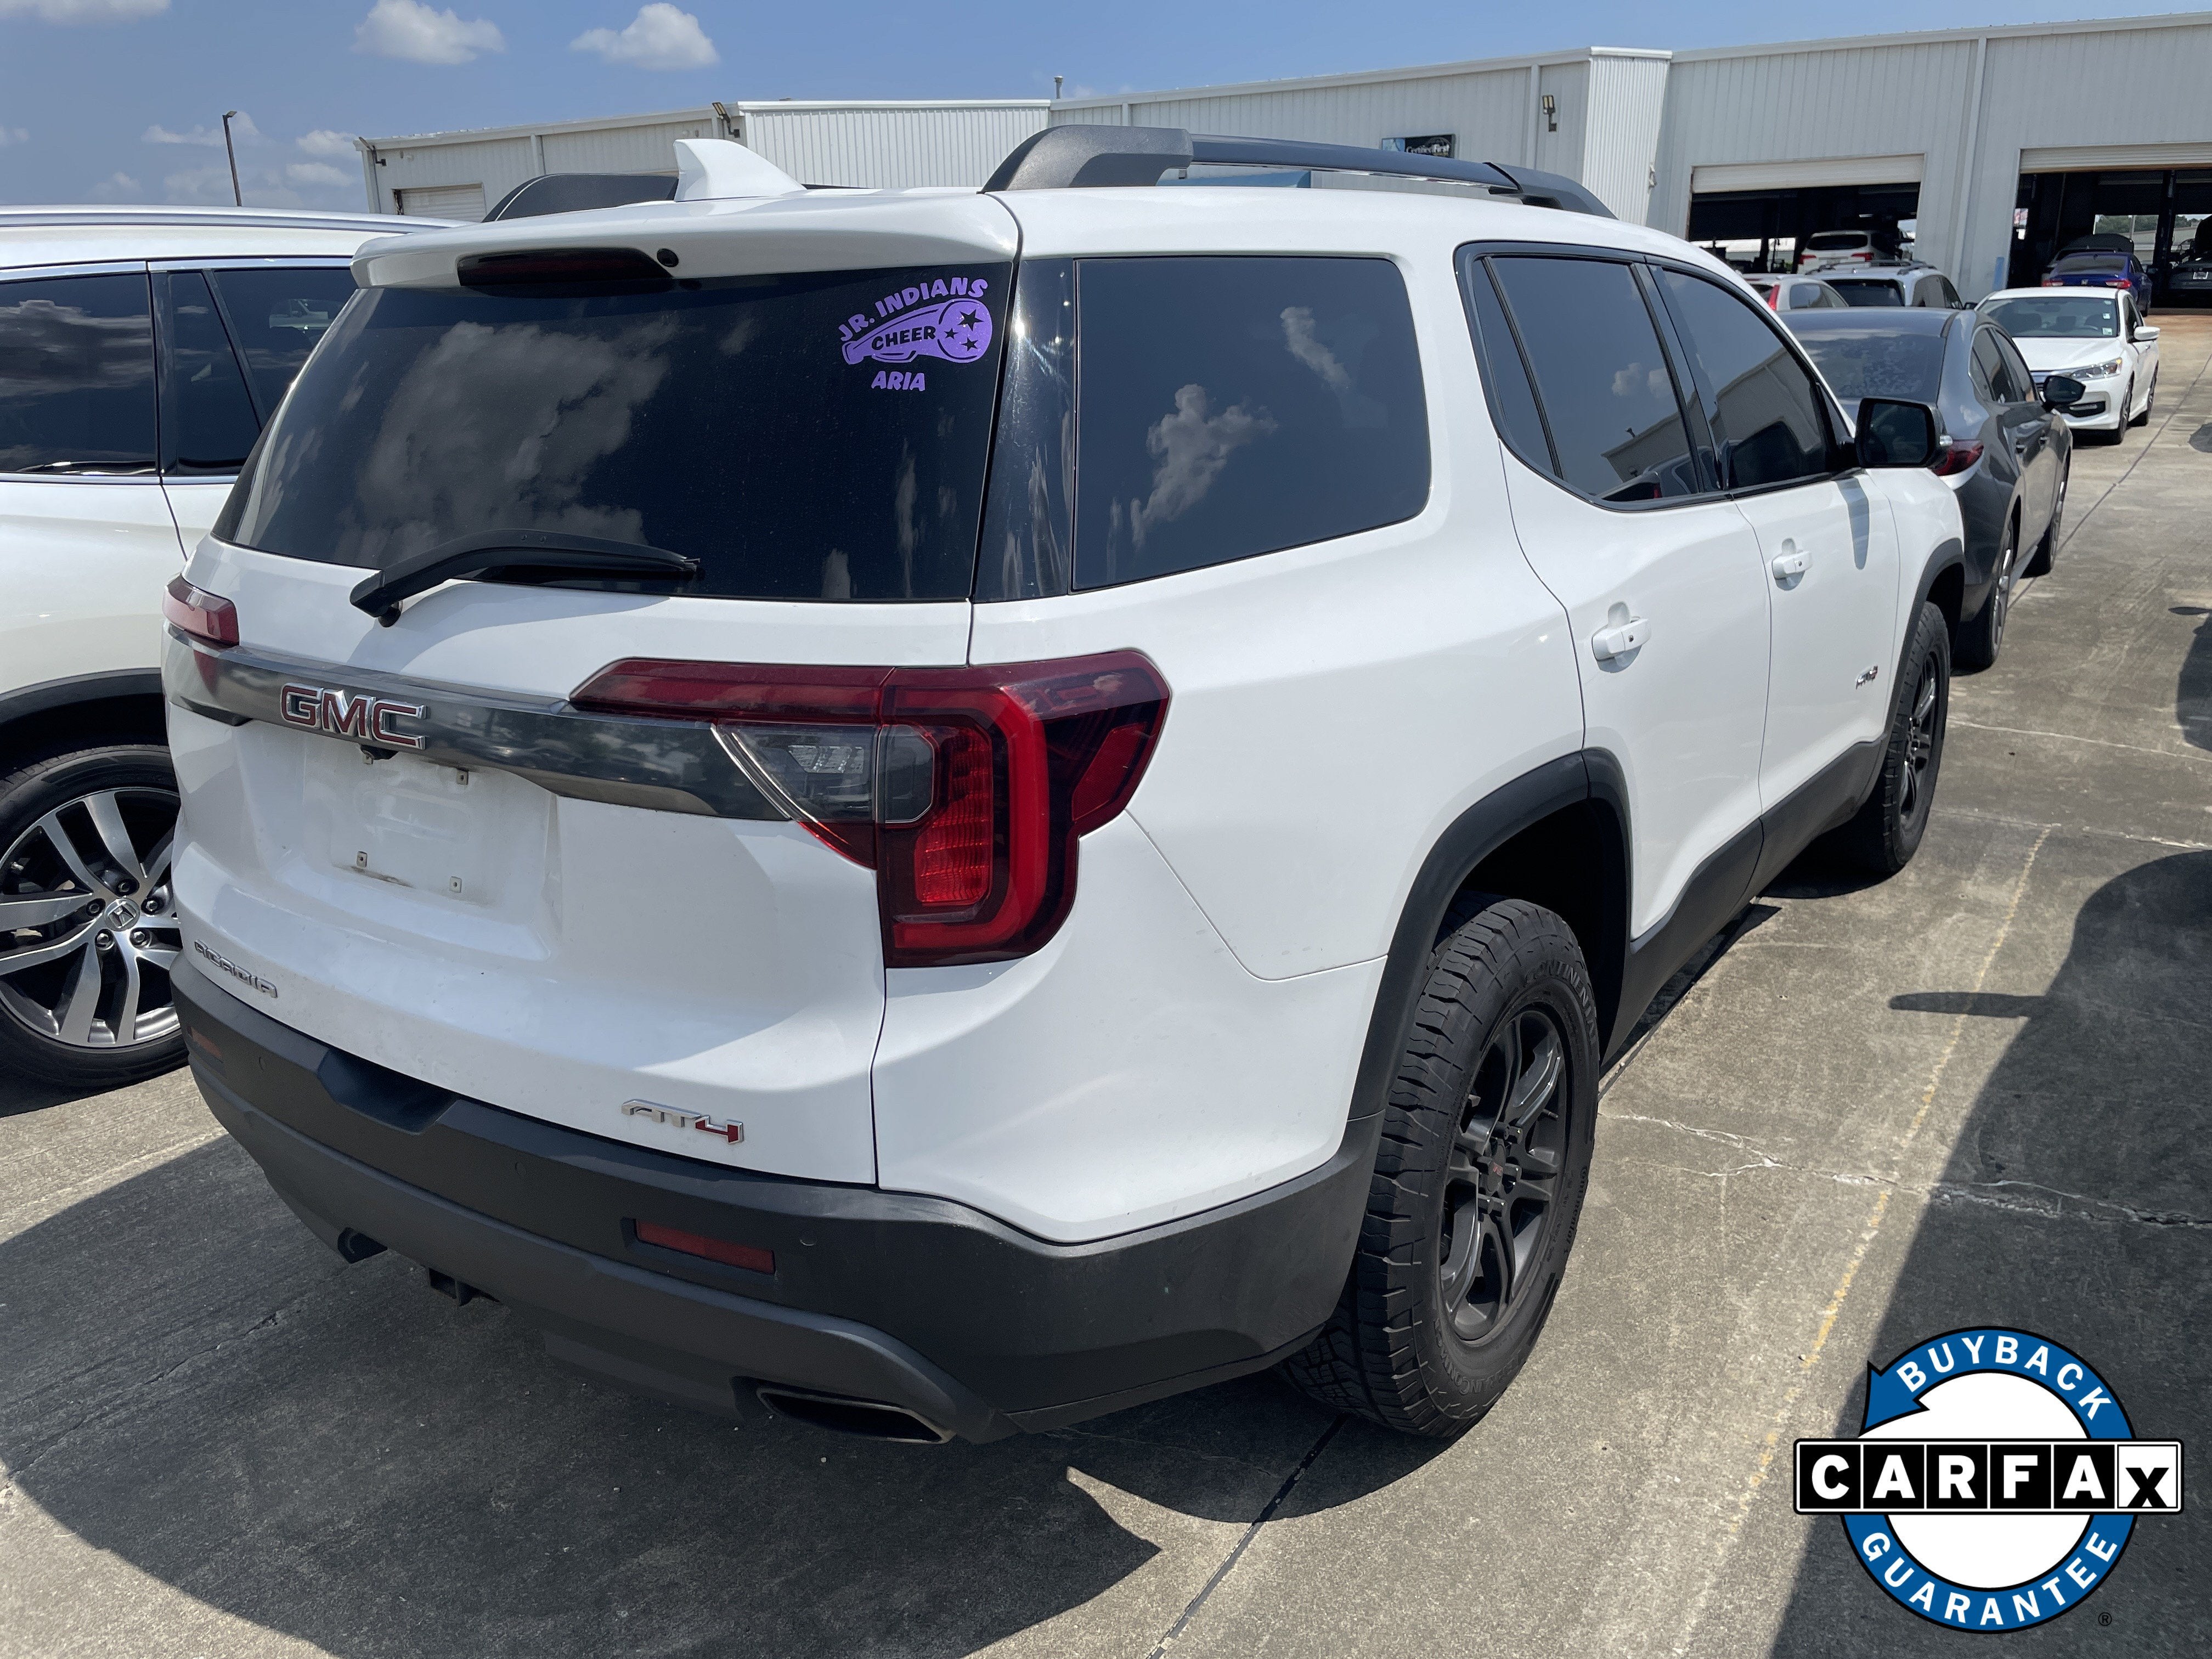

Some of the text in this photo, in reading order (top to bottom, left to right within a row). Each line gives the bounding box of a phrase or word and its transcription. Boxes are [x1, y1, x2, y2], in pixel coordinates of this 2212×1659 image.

[838, 277, 988, 342] JR. INDIANS
[871, 326, 936, 351] CHEER
[871, 370, 926, 392] ARIA
[280, 682, 427, 751] GMC
[194, 939, 278, 998] ACADIA
[621, 1098, 744, 1144] AT4
